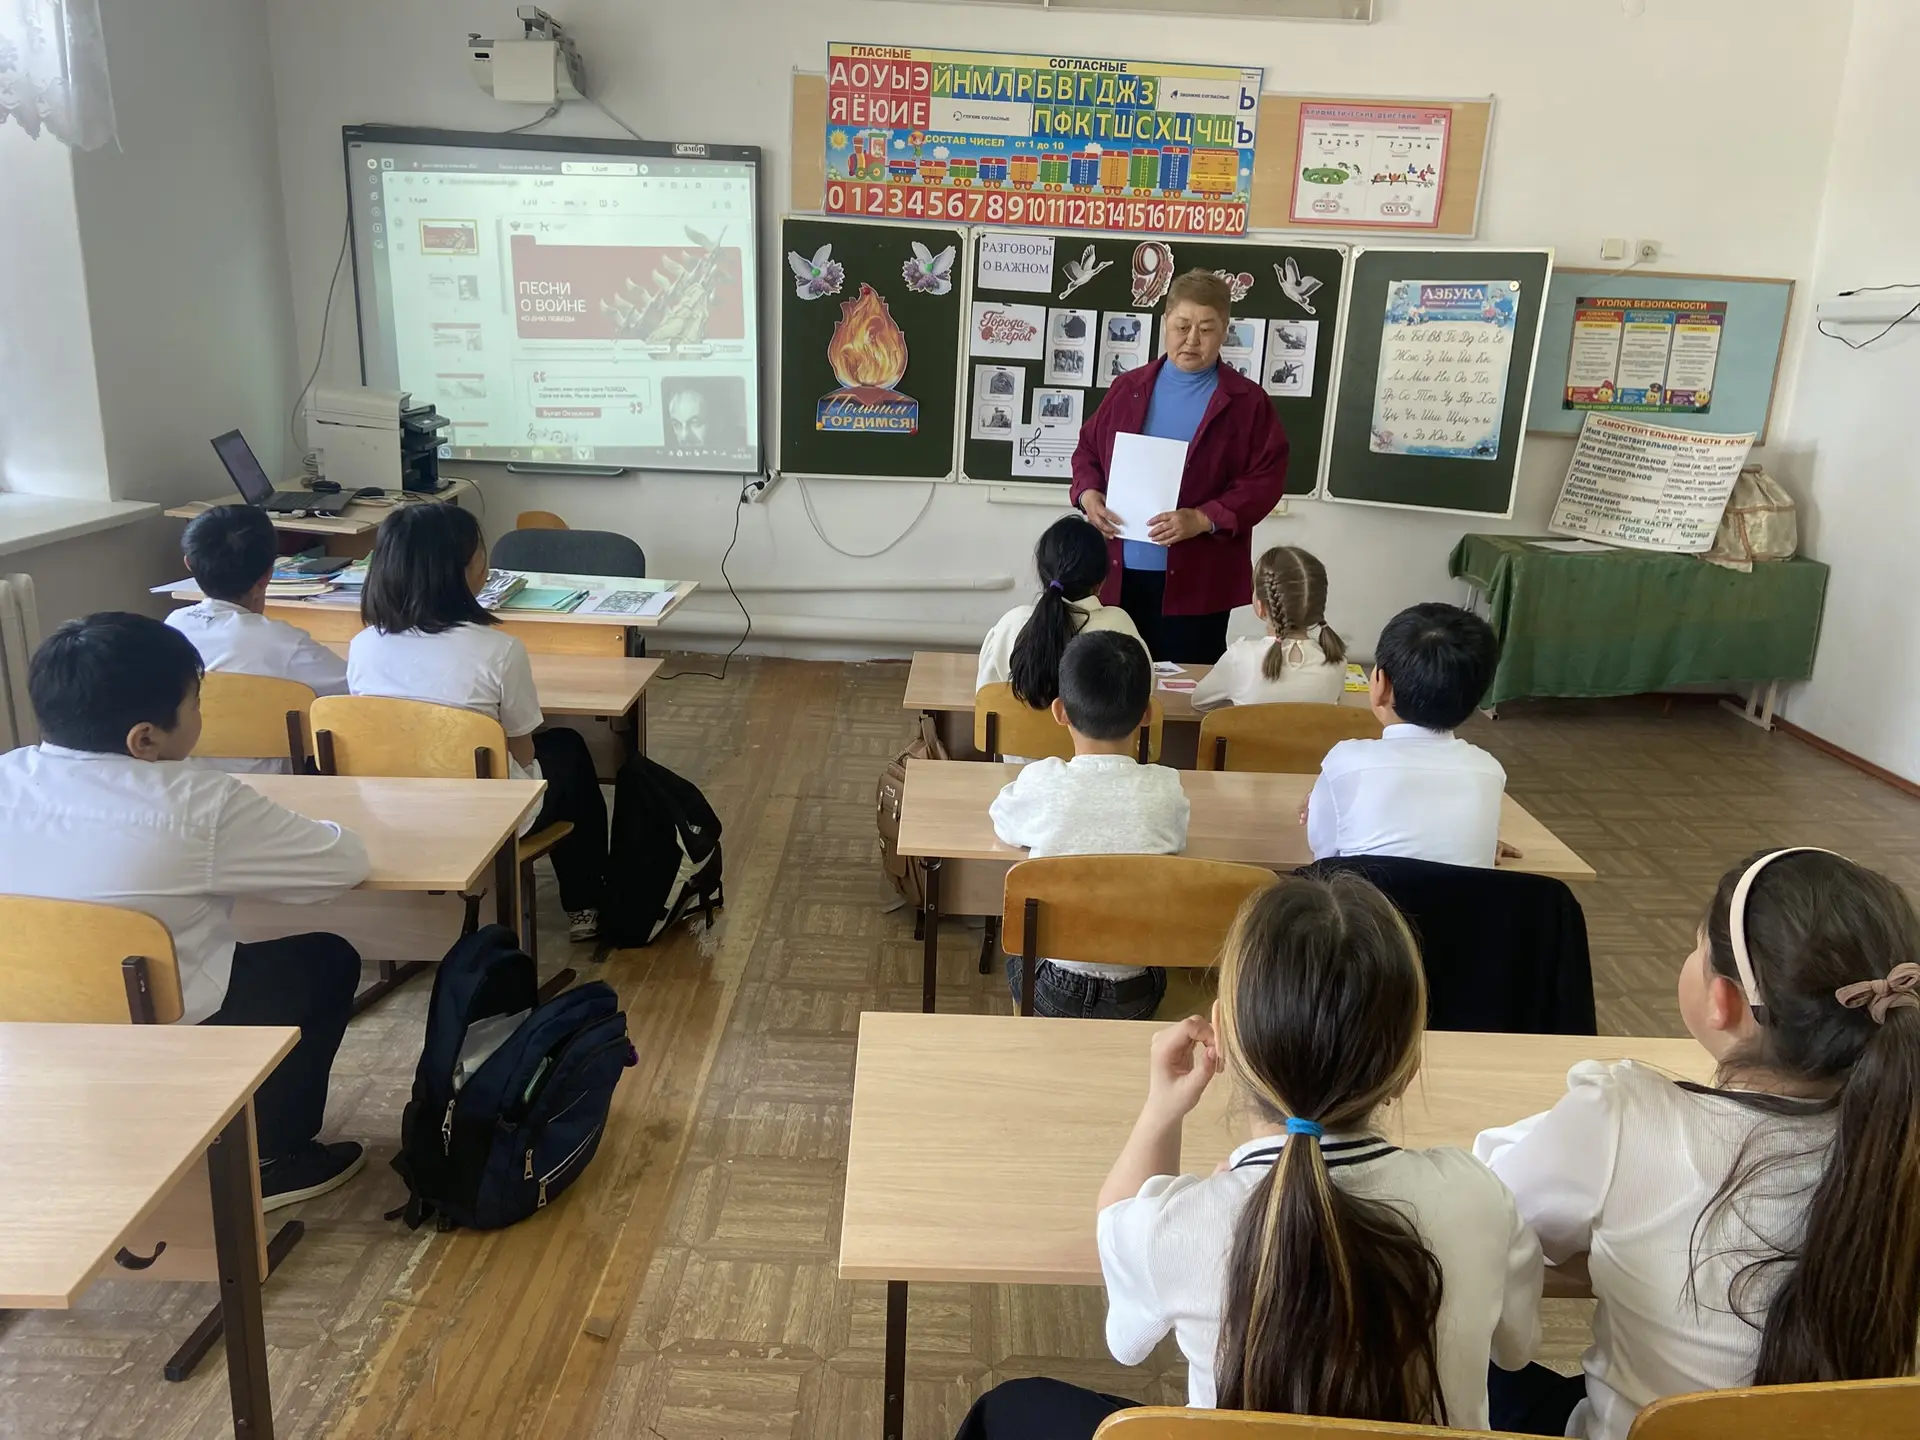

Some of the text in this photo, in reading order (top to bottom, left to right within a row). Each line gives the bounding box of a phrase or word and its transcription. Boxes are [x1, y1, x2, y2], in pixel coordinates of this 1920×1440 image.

[850, 46, 912, 59] ГЛАСНЫЕ
[1049, 58, 1128, 73] СОГЛАСНЫЕ
[925, 134, 967, 145] СОСТАВ
[969, 137, 1005, 148] ЧИСЕЛ
[1029, 140, 1035, 148] 1
[1037, 142, 1050, 150] до
[1052, 141, 1065, 150] 10
[828, 185, 1246, 233] 0 1 2 3 4 5 6 7 8 9 10 11 12 13 14 15 16 17 18 19 20
[981, 242, 1053, 256] РАЗГОВОРЫ
[983, 260, 1049, 275] О ВАЖНОМ
[519, 281, 571, 295] ПЕСНИ
[1422, 287, 1484, 300] АЗБУКА
[520, 295, 587, 313] О ВОЙНЕ
[1596, 299, 1707, 310] УГОЛОК БЕЗОПАСНОСТИ
[821, 415, 915, 429] ГОРДИМСЯ!
[1585, 426, 1678, 451] Имя существительное
[1596, 418, 1689, 442] САМОСТОЯТЕЛЬНЫЕ
[1690, 437, 1722, 445] ЧАСТИ
[1580, 442, 1596, 451] Имя
[1597, 447, 1667, 466] прилагательное
[1575, 459, 1653, 481] Имя числительное
[1569, 473, 1597, 487] Глагол
[1565, 488, 1621, 506] Местоимение
[1565, 512, 1588, 524] Союз
[1584, 508, 1643, 525] СЛУЖЕБНЫЕ
[1644, 519, 1673, 528] ЧАСТИ
[1619, 523, 1655, 536] Предлог
